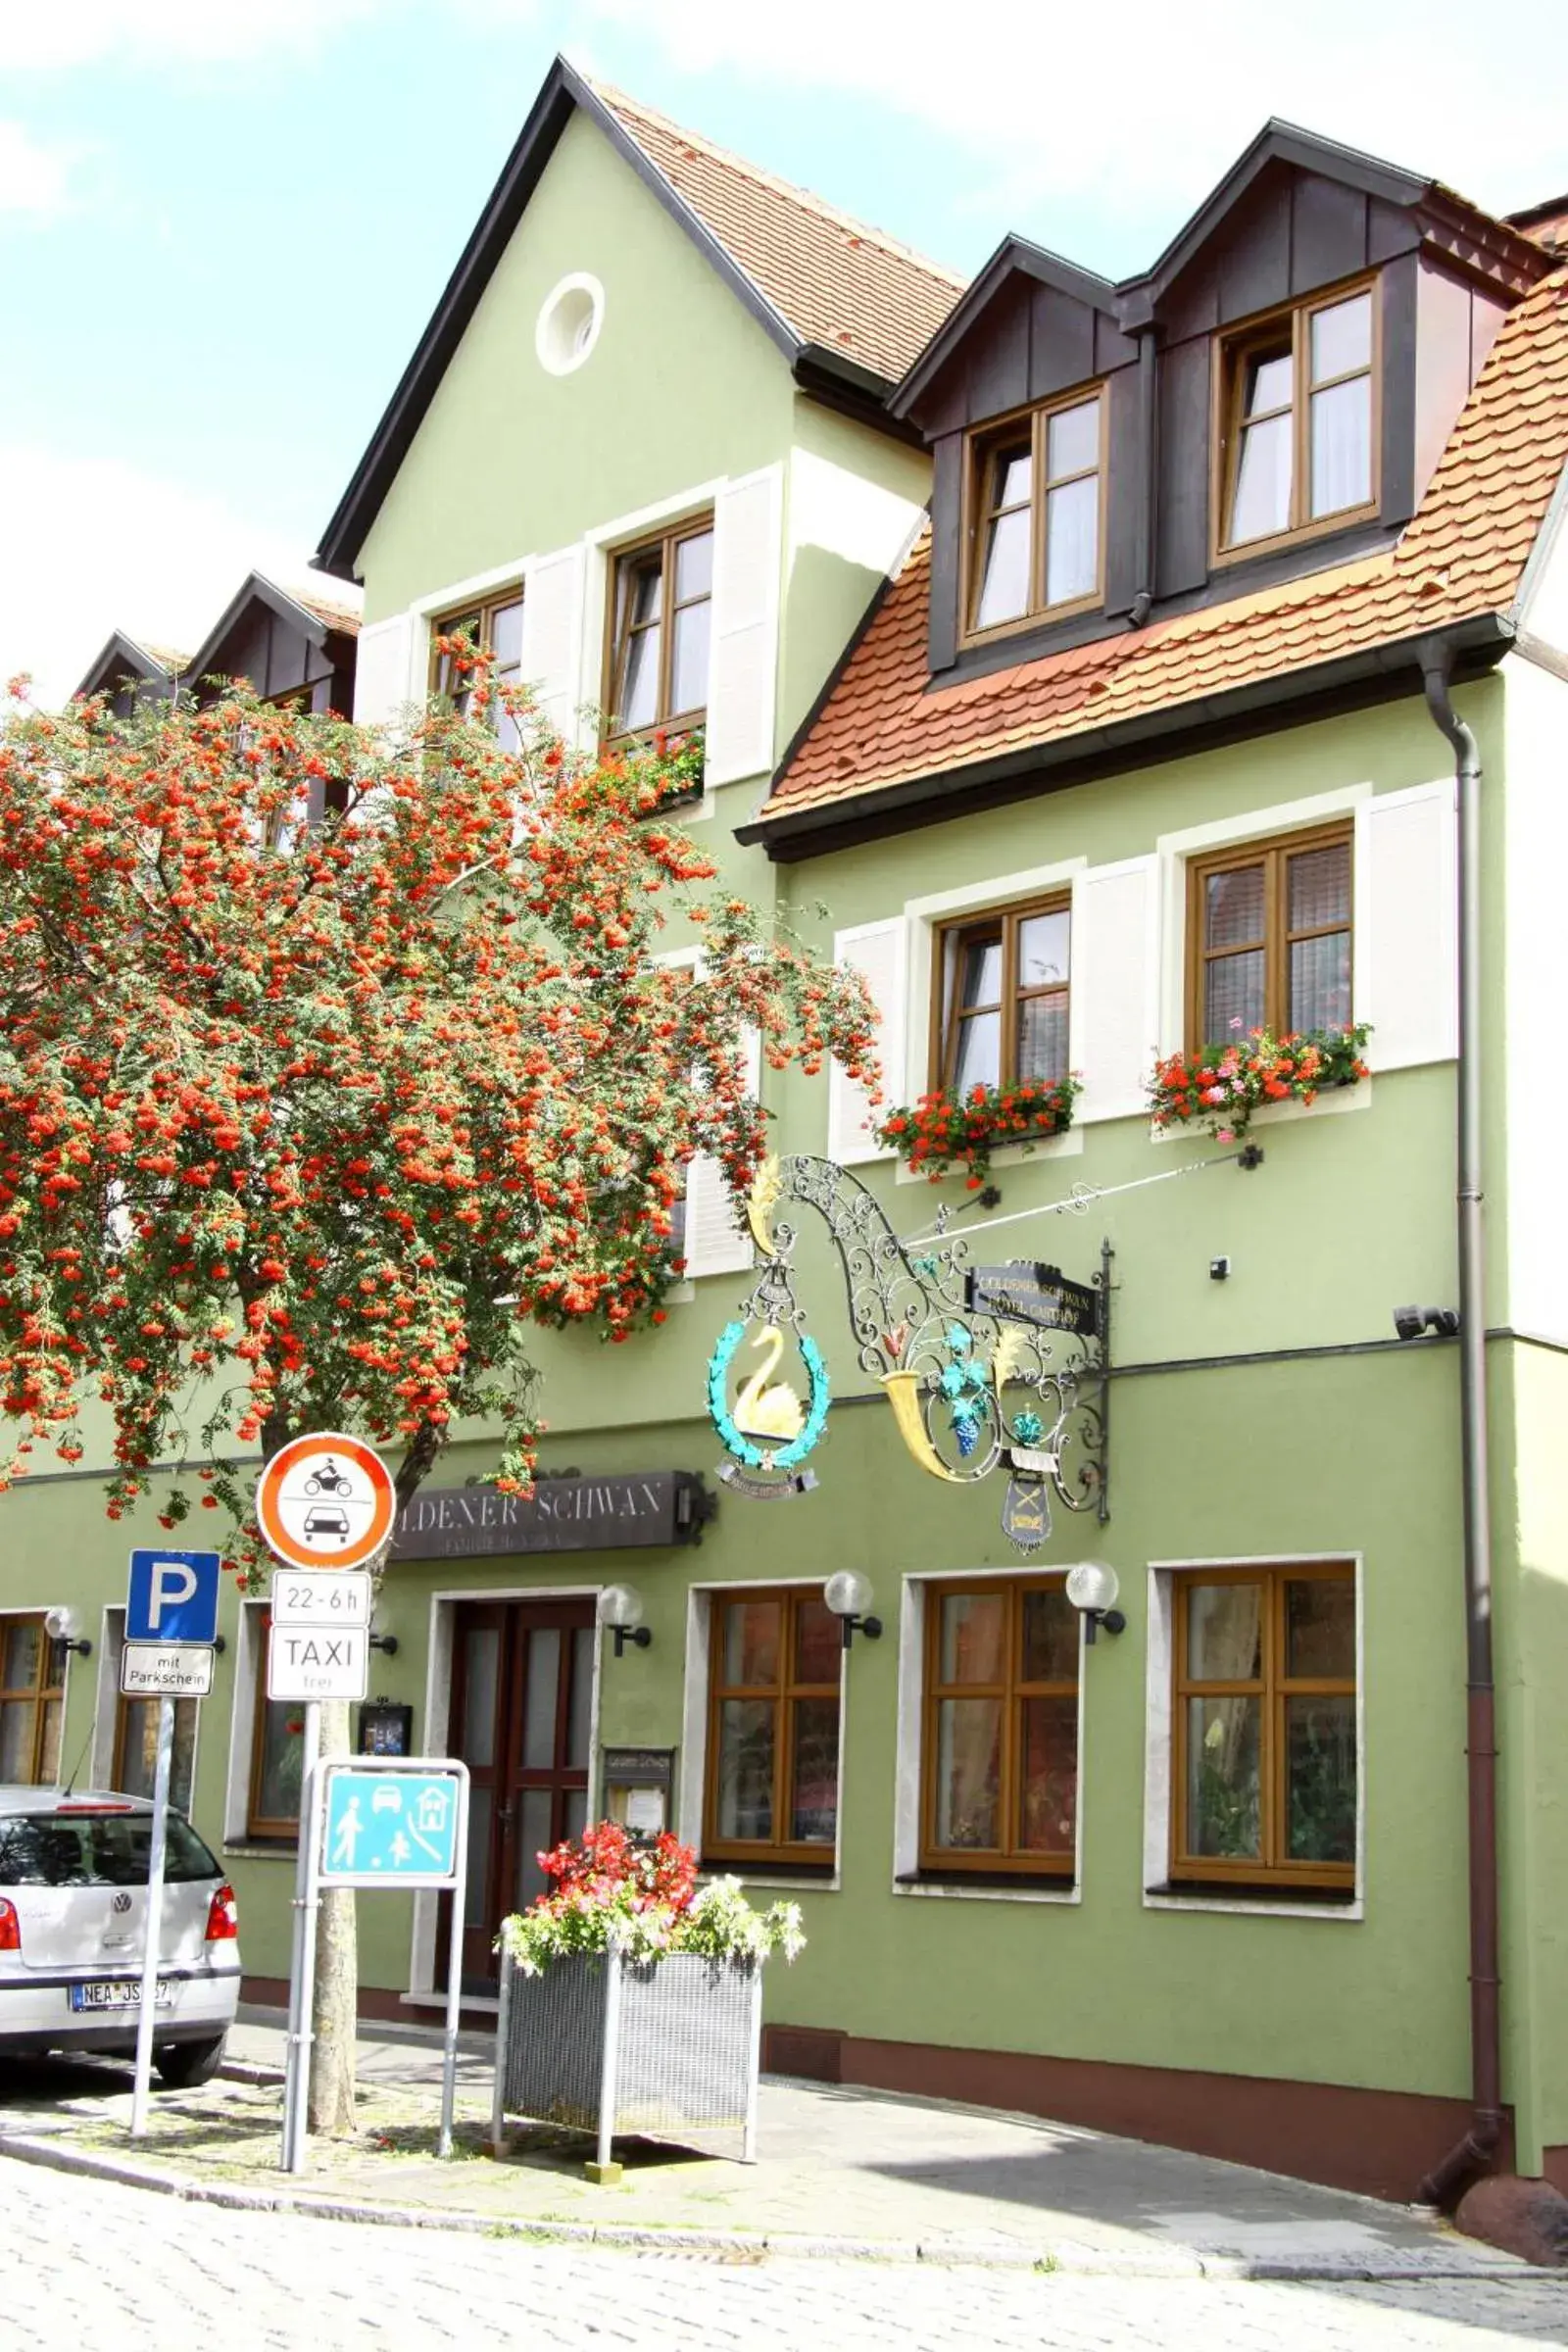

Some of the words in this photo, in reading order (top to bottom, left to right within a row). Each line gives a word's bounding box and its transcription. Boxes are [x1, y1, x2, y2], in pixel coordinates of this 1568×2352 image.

[538, 1482, 662, 1521] SCHWAN
[148, 1562, 197, 1630] P
[157, 1655, 180, 1669] mit
[284, 1639, 353, 1667] TAXI
[129, 1669, 205, 1686] Parkschein
[84, 1983, 112, 2003] NEA
